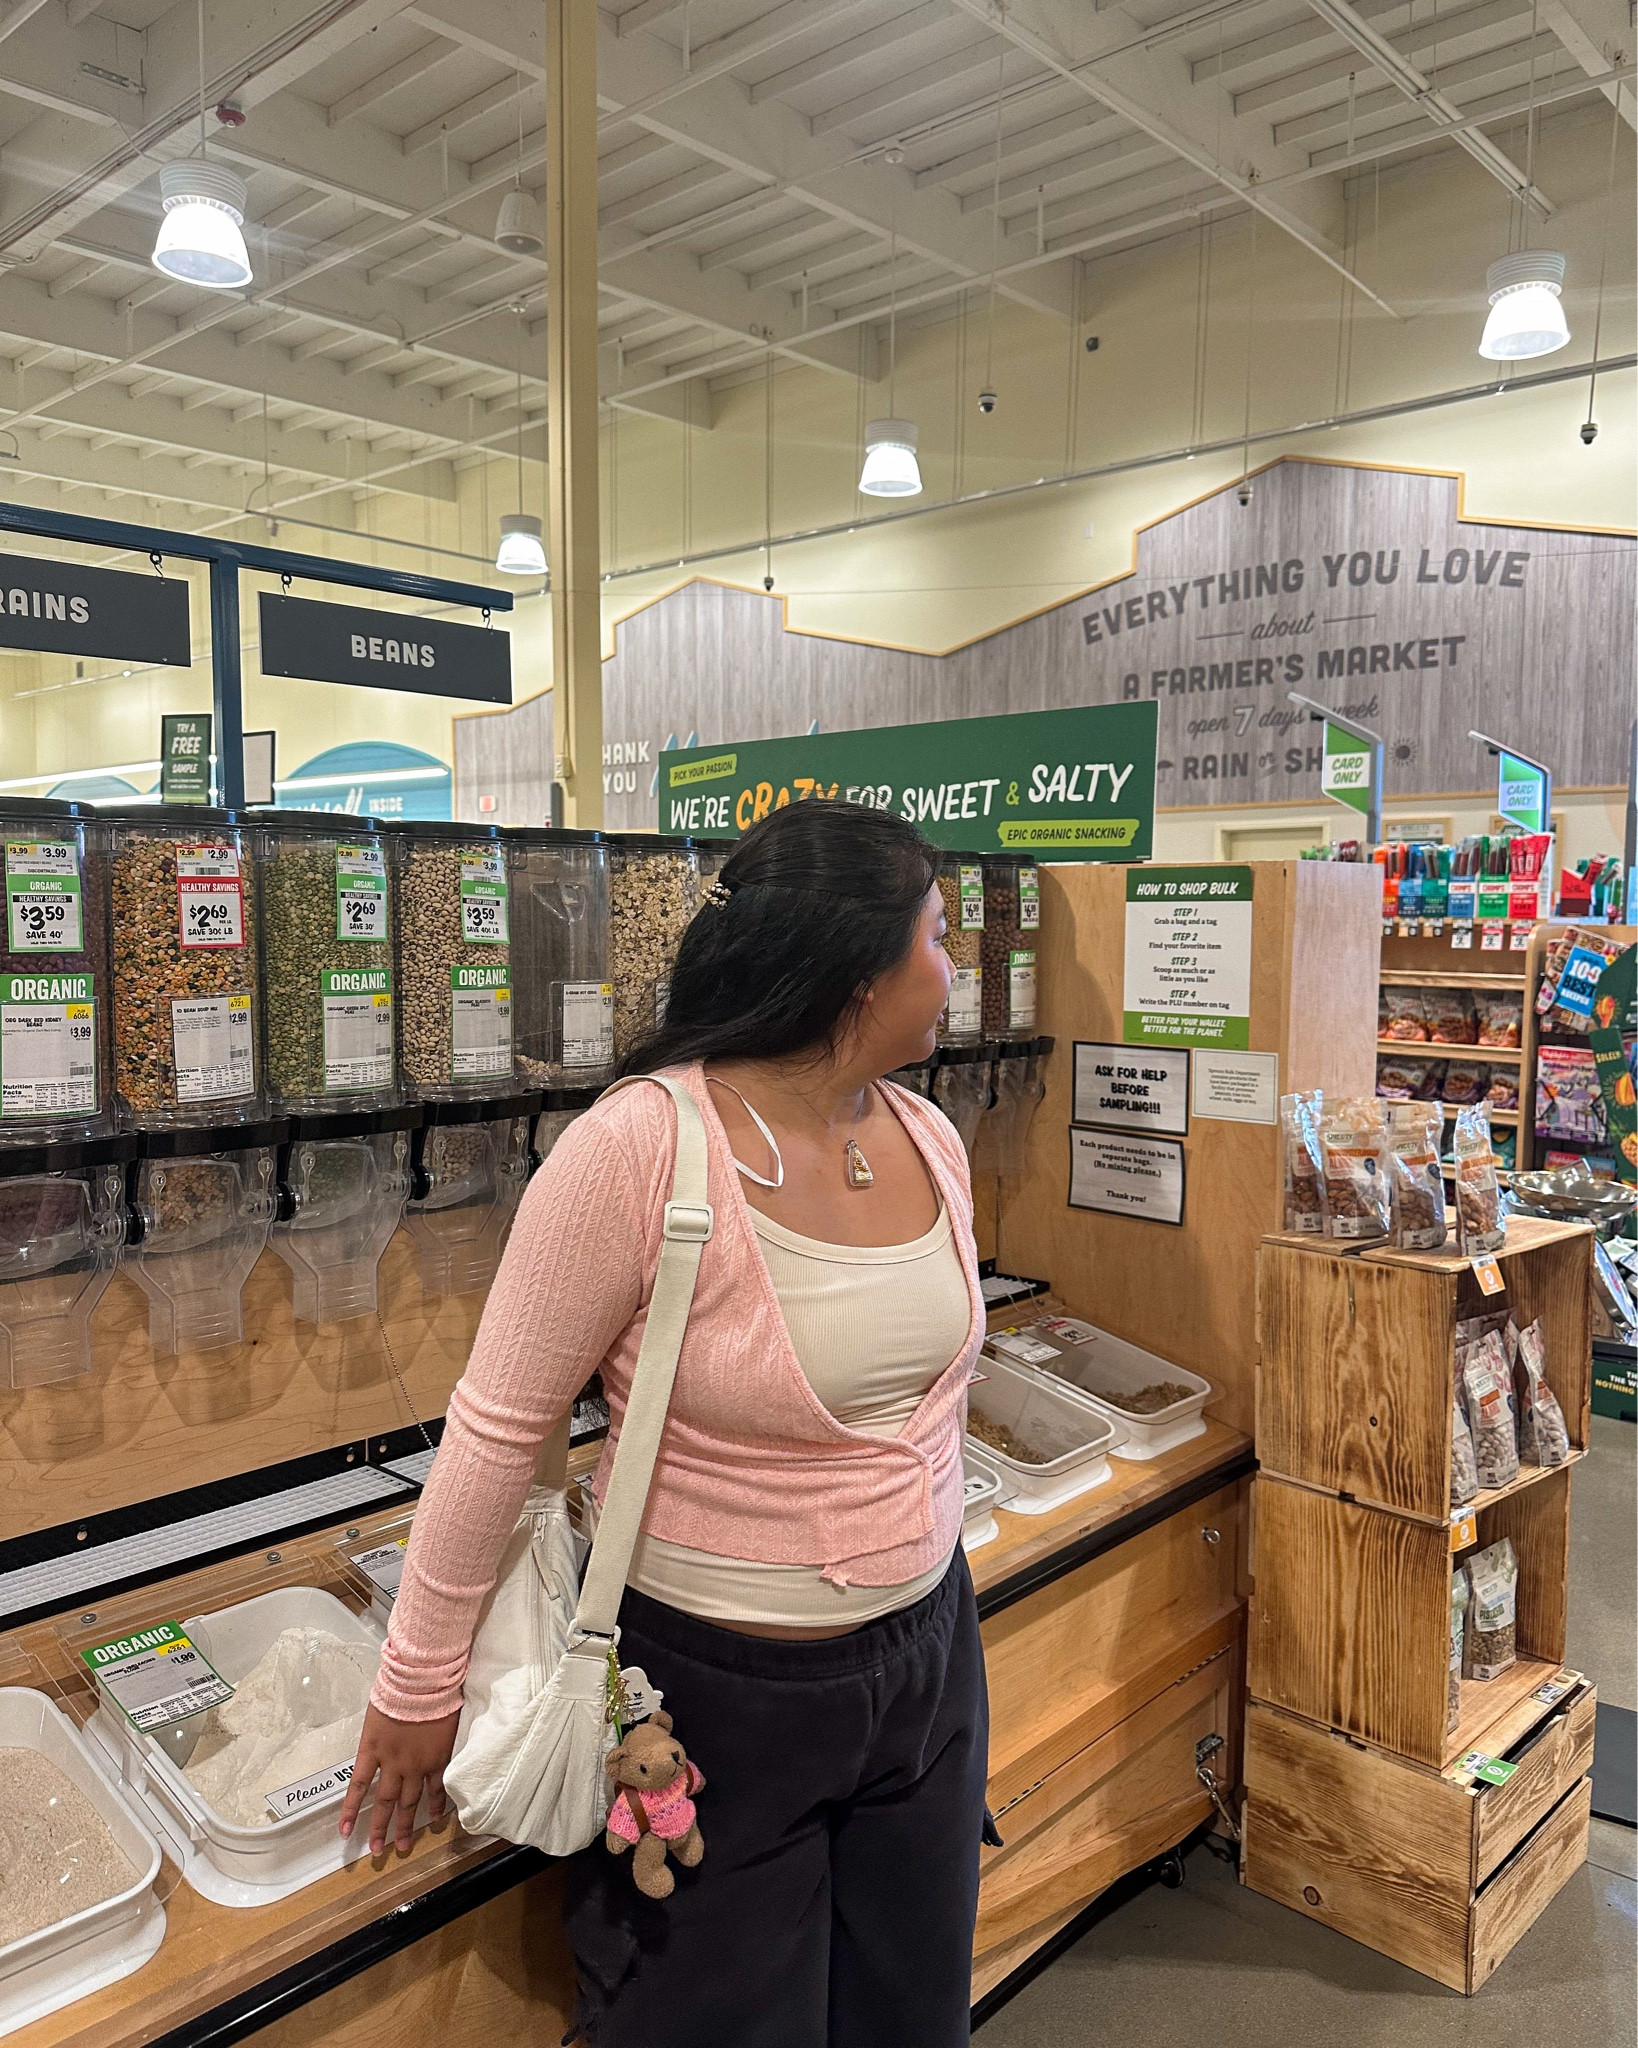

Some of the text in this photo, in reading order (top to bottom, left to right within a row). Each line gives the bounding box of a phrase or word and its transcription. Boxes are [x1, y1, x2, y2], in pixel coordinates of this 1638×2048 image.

[1082, 549, 1531, 645] EVERYTHING YOU LOVE
[1251, 610, 1316, 641] about
[351, 635, 436, 668] BEANS
[1123, 635, 1466, 700] A FARMER'S MARKET
[176, 723, 196, 734] TRY A
[1187, 716, 1229, 740] open
[1233, 705, 1254, 737] 7
[1258, 705, 1305, 737] days
[171, 736, 202, 755] FREE
[172, 763, 198, 774] SAMPLE
[1182, 752, 1248, 781] RAIN
[1332, 757, 1363, 771] CARD
[673, 761, 733, 782] PICK YOUR PASSION
[1333, 771, 1362, 784] ONLY
[602, 770, 637, 795] YOU
[671, 795, 731, 830] WE'RE
[900, 778, 1000, 823] SWEET
[1005, 781, 1020, 805] &
[1028, 762, 1134, 804] SALTY
[1506, 784, 1534, 796] CARD
[369, 797, 403, 813] INSIDE
[1507, 796, 1534, 807] ONLY
[1007, 826, 1126, 841] EPIC ORGANIC SNACKING
[9, 847, 67, 858] $3.99 $3.99
[208, 849, 229, 859] $2.99
[362, 852, 379, 862] $2.99
[30, 881, 63, 891] ORGANIC
[181, 883, 239, 892] HEALTHY SAVINGS
[353, 880, 376, 890] ORGANIC
[475, 886, 496, 896] ORGANIC
[1136, 881, 1239, 896] HOW TO SHOP BULK
[19, 895, 67, 903] HEALTHY SAVINGS
[1173, 908, 1198, 917] STEP 1
[1175, 918, 1188, 926] bag
[1206, 918, 1218, 926] tag
[26, 931, 47, 939] SAVE
[187, 928, 206, 936] SAVE
[1172, 932, 1199, 941] STEP 2
[1164, 943, 1179, 951] your
[1179, 942, 1206, 950] favorite
[1171, 957, 1198, 966] STEP 3
[1153, 966, 1172, 975] Scoop
[330, 972, 386, 991] ORGANIC
[458, 968, 507, 987] ORGANIC
[11, 978, 86, 1001] ORGANIC
[1562, 975, 1598, 998] BEST
[1170, 990, 1197, 999] STEP 4
[230, 1000, 244, 1008] 6721
[1139, 998, 1157, 1006] Write
[1158, 998, 1168, 1006] the
[1183, 999, 1209, 1008] number
[1219, 1002, 1230, 1010] tag
[73, 1012, 89, 1020] 6066
[229, 1011, 248, 1024] $2.99
[376, 1012, 390, 1024] $2.99
[1141, 1015, 1165, 1024] BETTER
[1166, 1017, 1180, 1025] FOR
[1180, 1018, 1199, 1026] YOUR
[70, 1026, 91, 1038] $3.99
[1143, 1025, 1168, 1033] BETTER
[1168, 1026, 1182, 1034] FOR
[1183, 1027, 1196, 1035] THE
[1095, 1064, 1168, 1082] ASK FOR HELP
[1111, 1082, 1150, 1097] BEFORE
[1099, 1096, 1161, 1115] SAMPLING!!!
[1080, 1140, 1176, 1160] Each product needs to be in
[1102, 1153, 1153, 1167] separate bags.
[1093, 1160, 1162, 1178] (No mixing please.)
[1106, 1189, 1147, 1203] Thank you!
[1609, 1374, 1626, 1385] THE
[1595, 1378, 1635, 1396] NOTHING
[93, 1626, 175, 1663] ORGANIC
[171, 1651, 196, 1664] $1.99
[130, 1704, 159, 1717] Nutrition
[286, 1780, 335, 1807] Please
